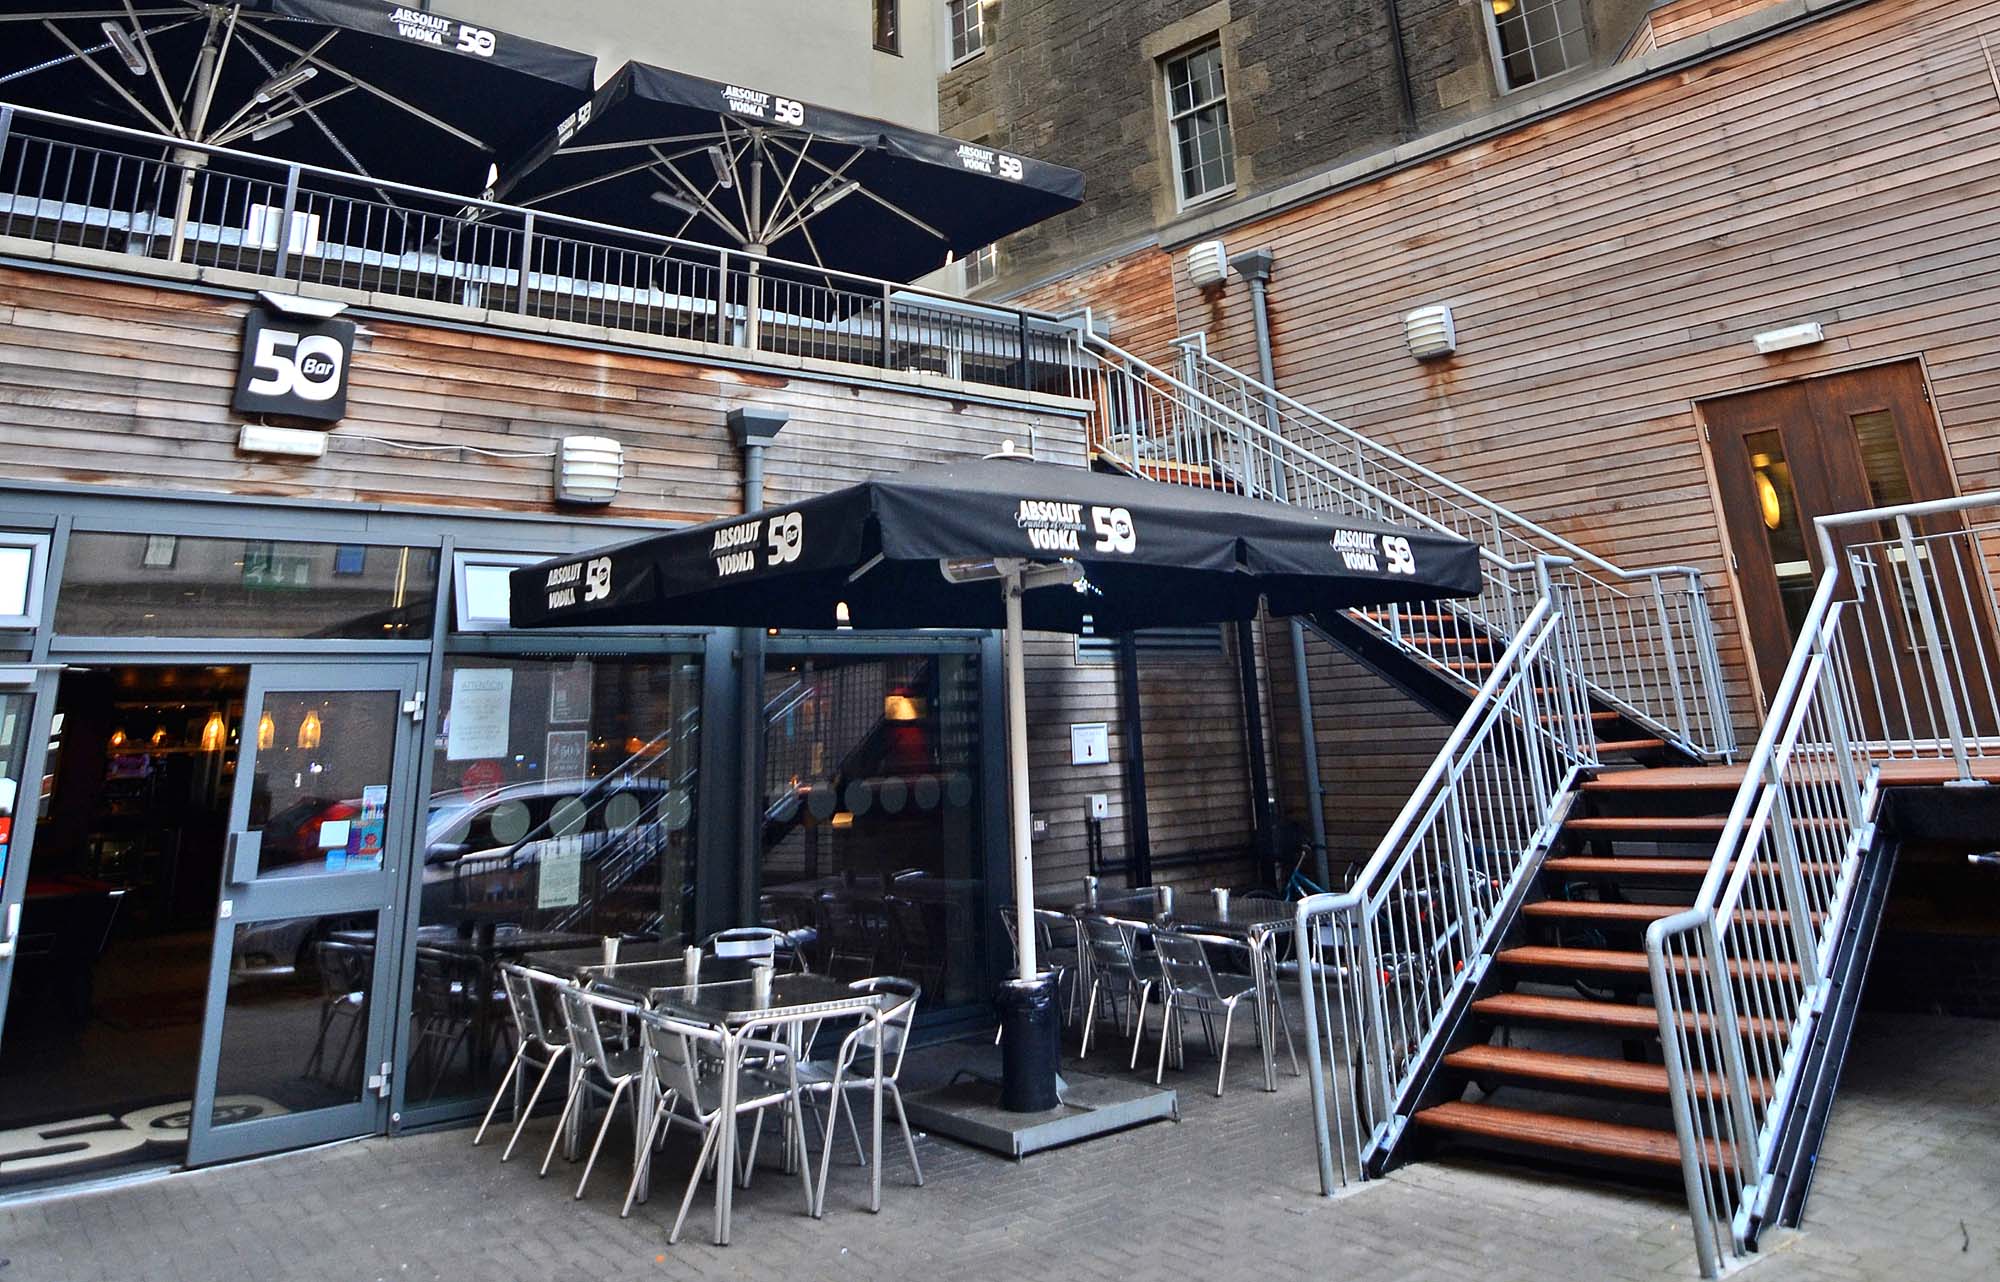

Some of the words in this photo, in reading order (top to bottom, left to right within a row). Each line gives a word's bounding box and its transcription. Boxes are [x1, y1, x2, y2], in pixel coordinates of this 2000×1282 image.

[394, 8, 452, 32] ABSOLUT
[398, 23, 442, 45] VODKA
[456, 25, 496, 56] 50
[726, 85, 770, 105] ABSOLUT
[729, 100, 764, 117] VODKA
[959, 144, 994, 161] ABSOLUT
[963, 157, 992, 173] VODKA
[247, 328, 344, 401] 50
[303, 358, 334, 375] Bar
[1019, 500, 1083, 524] ABSOLUT
[713, 520, 762, 551] ABSOLUT
[768, 512, 803, 566] 50
[1028, 529, 1080, 551] VODKA
[1091, 506, 1137, 554] 50
[1333, 529, 1377, 550] ABSOLUT
[717, 550, 755, 576] VODKA
[1342, 551, 1379, 572] VODKA
[547, 562, 582, 587] ABSOLUT
[584, 556, 612, 602] 50
[549, 587, 576, 610] VODKA
